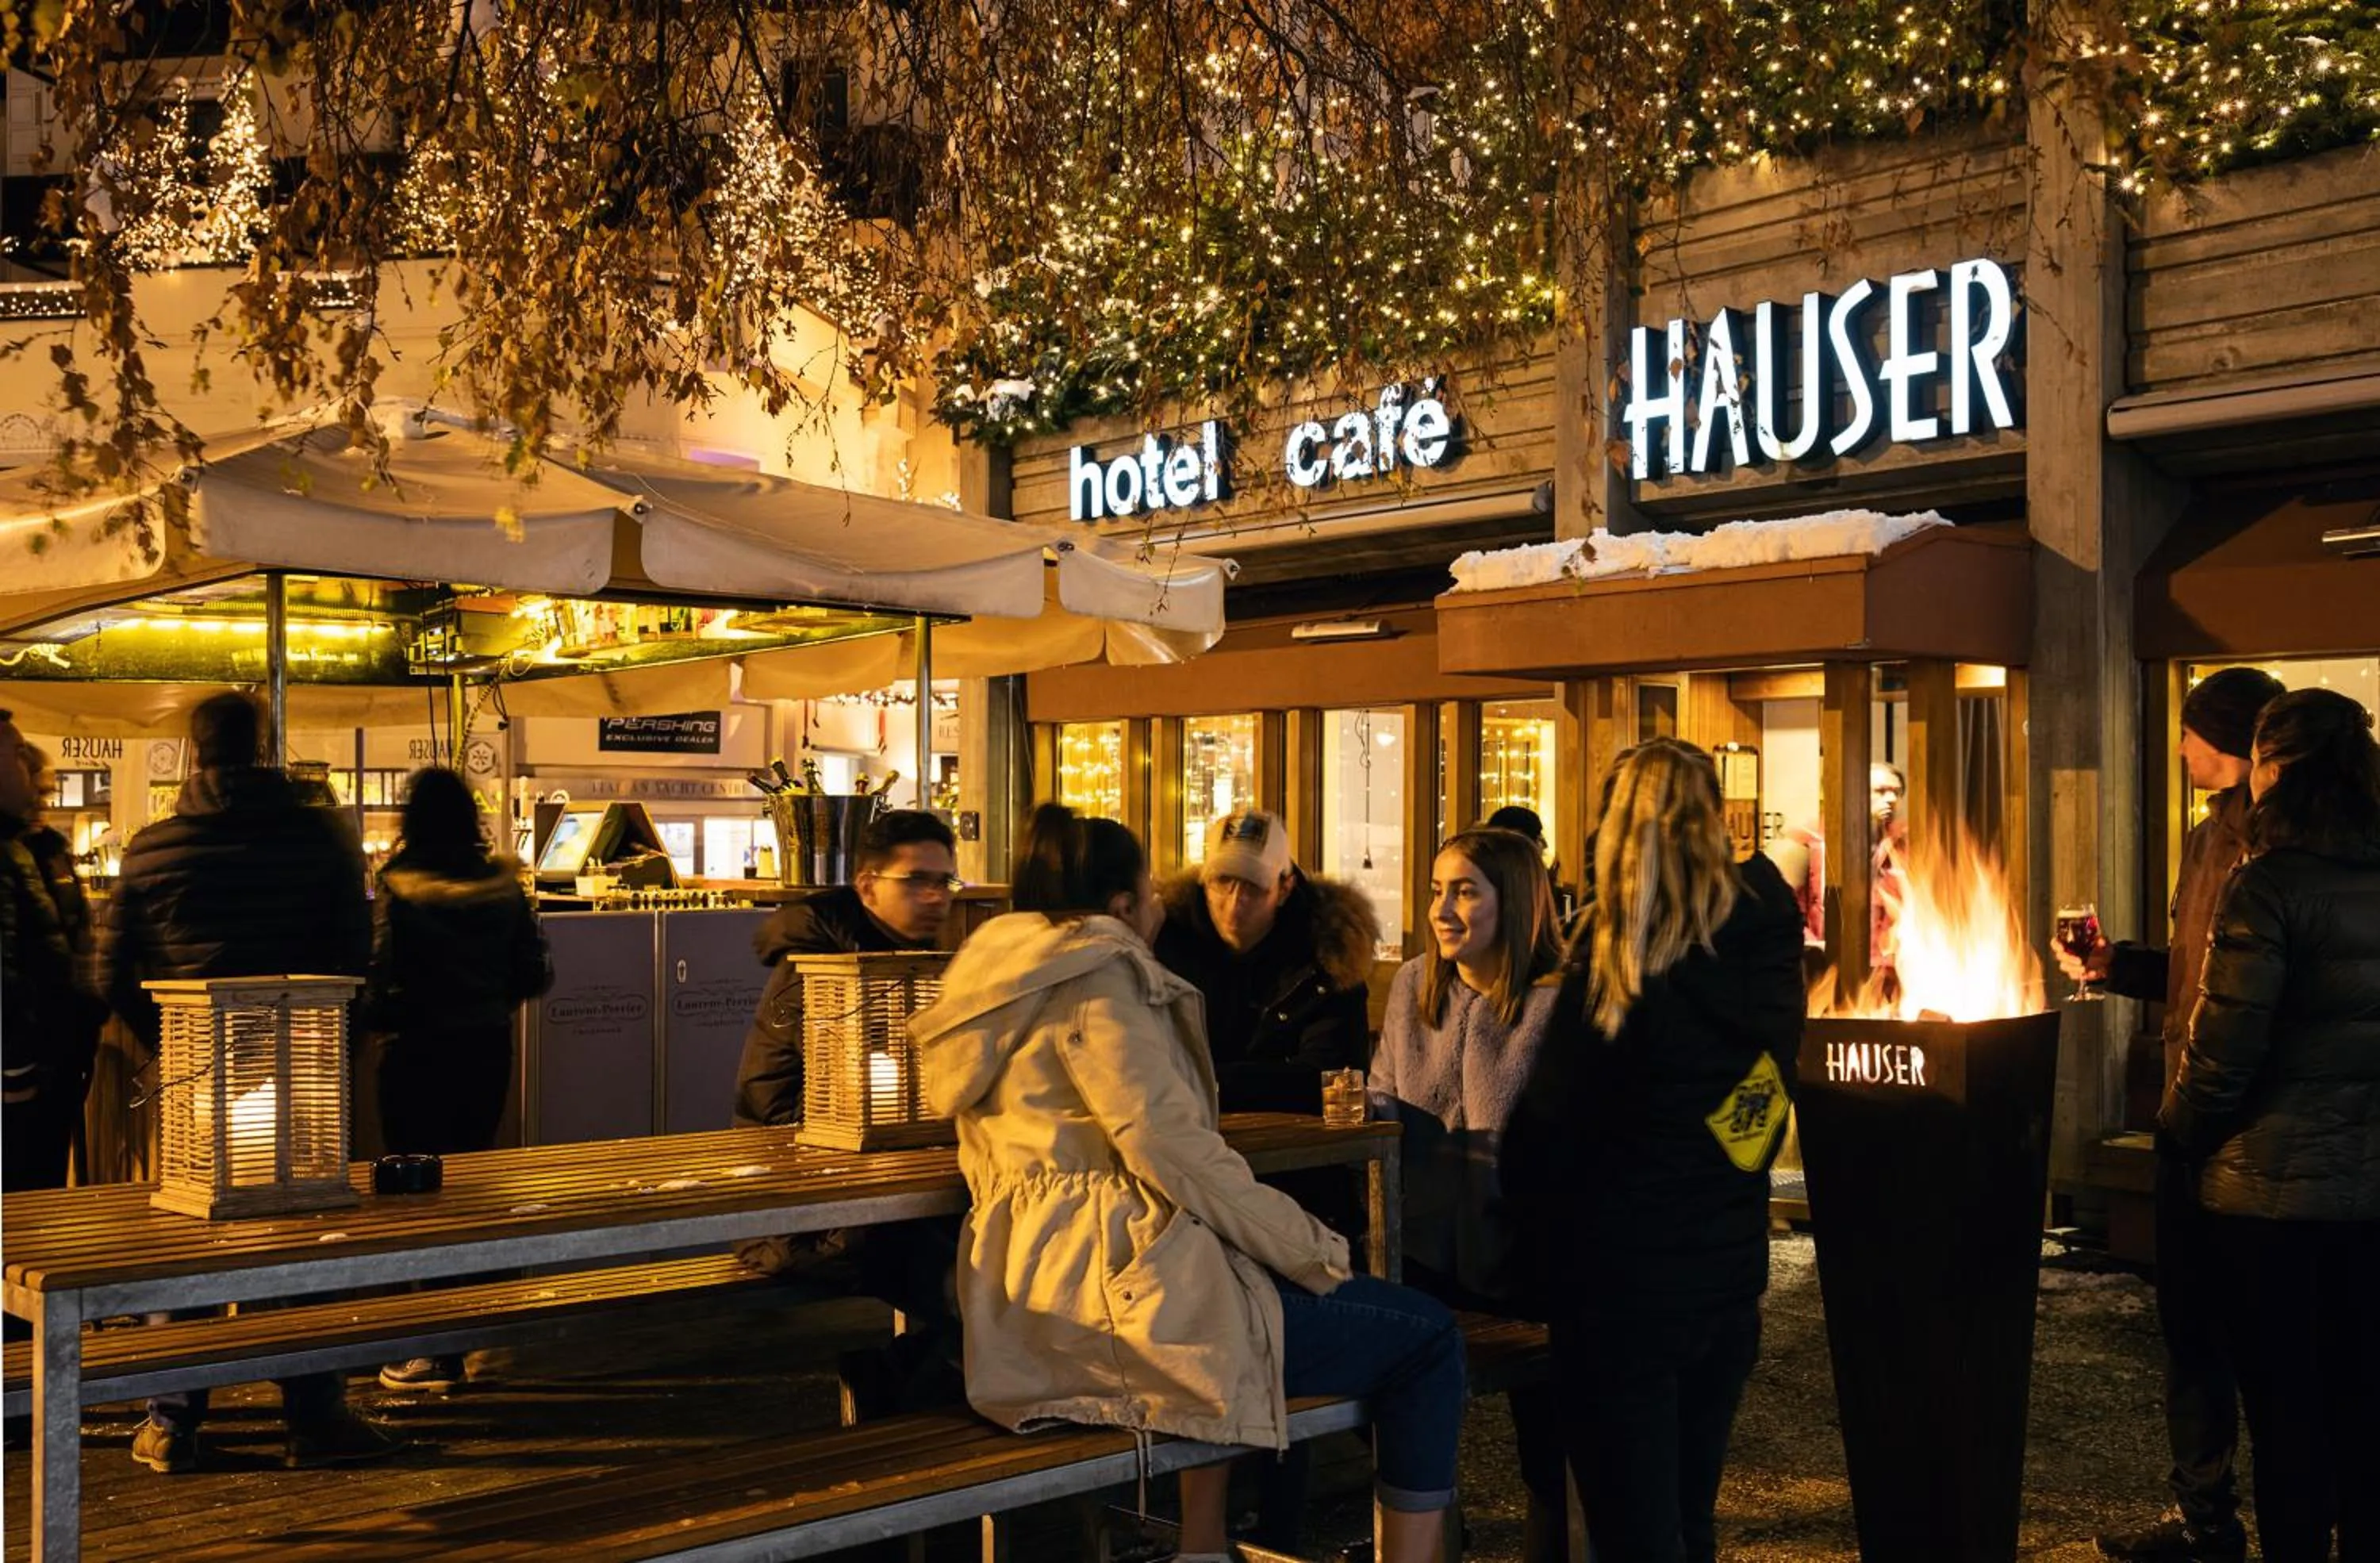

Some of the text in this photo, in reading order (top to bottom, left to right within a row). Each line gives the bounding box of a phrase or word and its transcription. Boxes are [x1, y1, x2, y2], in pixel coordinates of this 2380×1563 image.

[1623, 258, 2013, 479] HAUSER
[1070, 376, 1451, 520] hotel café
[605, 735, 714, 744] EXCLUSIVE DEALER
[607, 717, 716, 733] PERSHING
[1825, 1042, 1925, 1086] HAUSER
